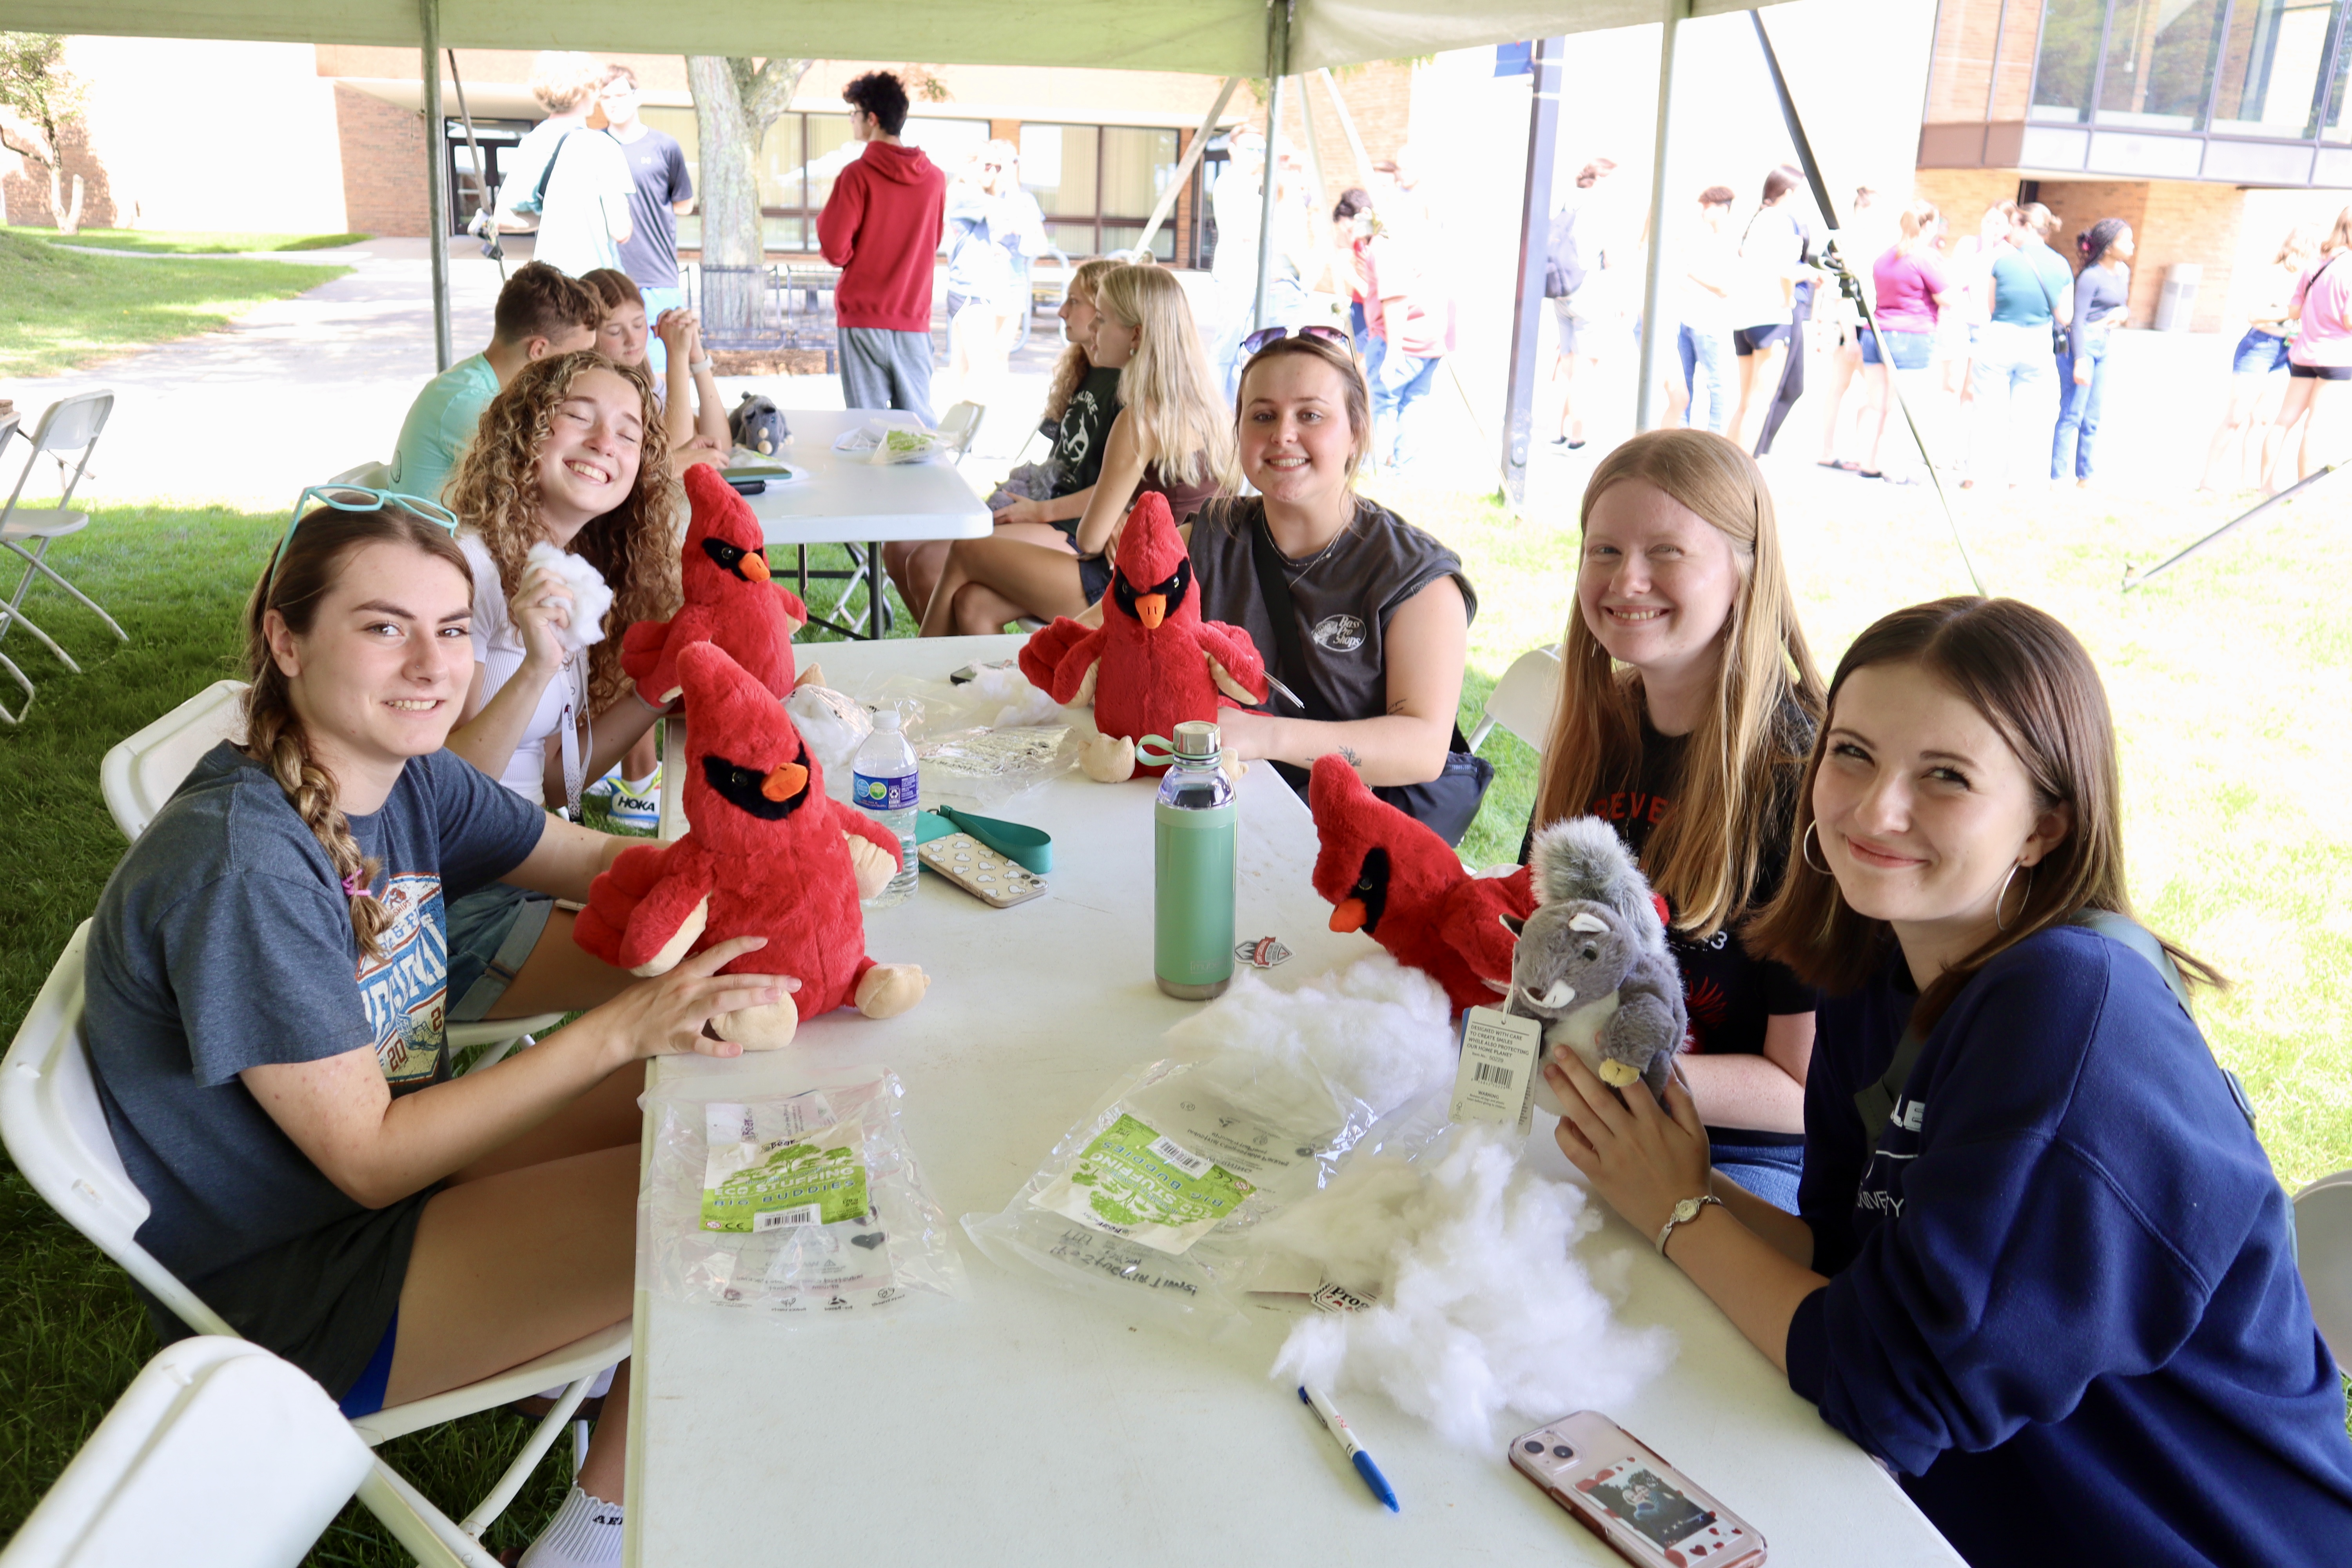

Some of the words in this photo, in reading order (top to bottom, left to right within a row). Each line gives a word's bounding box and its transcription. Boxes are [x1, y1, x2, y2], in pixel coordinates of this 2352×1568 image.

[1339, 616, 1360, 628] Bass
[1337, 626, 1353, 636] Pro
[1333, 634, 1361, 648] Shops
[618, 796, 655, 812] HOKA
[393, 901, 412, 916] SHIPS
[1471, 1024, 1495, 1034] DESIGNED
[1478, 1045, 1493, 1054] HOME
[1494, 1049, 1512, 1058] PLANET
[1497, 1044, 1529, 1056] PROTECTING
[1478, 1090, 1499, 1100] WARNING
[770, 1139, 796, 1150] Bear
[1102, 1141, 1182, 1190] BUDDIES
[714, 1186, 748, 1196] ECO
[755, 1167, 855, 1192] STUFFING
[1089, 1152, 1177, 1205] STUFFING
[762, 1180, 855, 1203] BUDDIES
[1190, 1192, 1224, 1207] BIG
[1180, 1203, 1212, 1218] ECO
